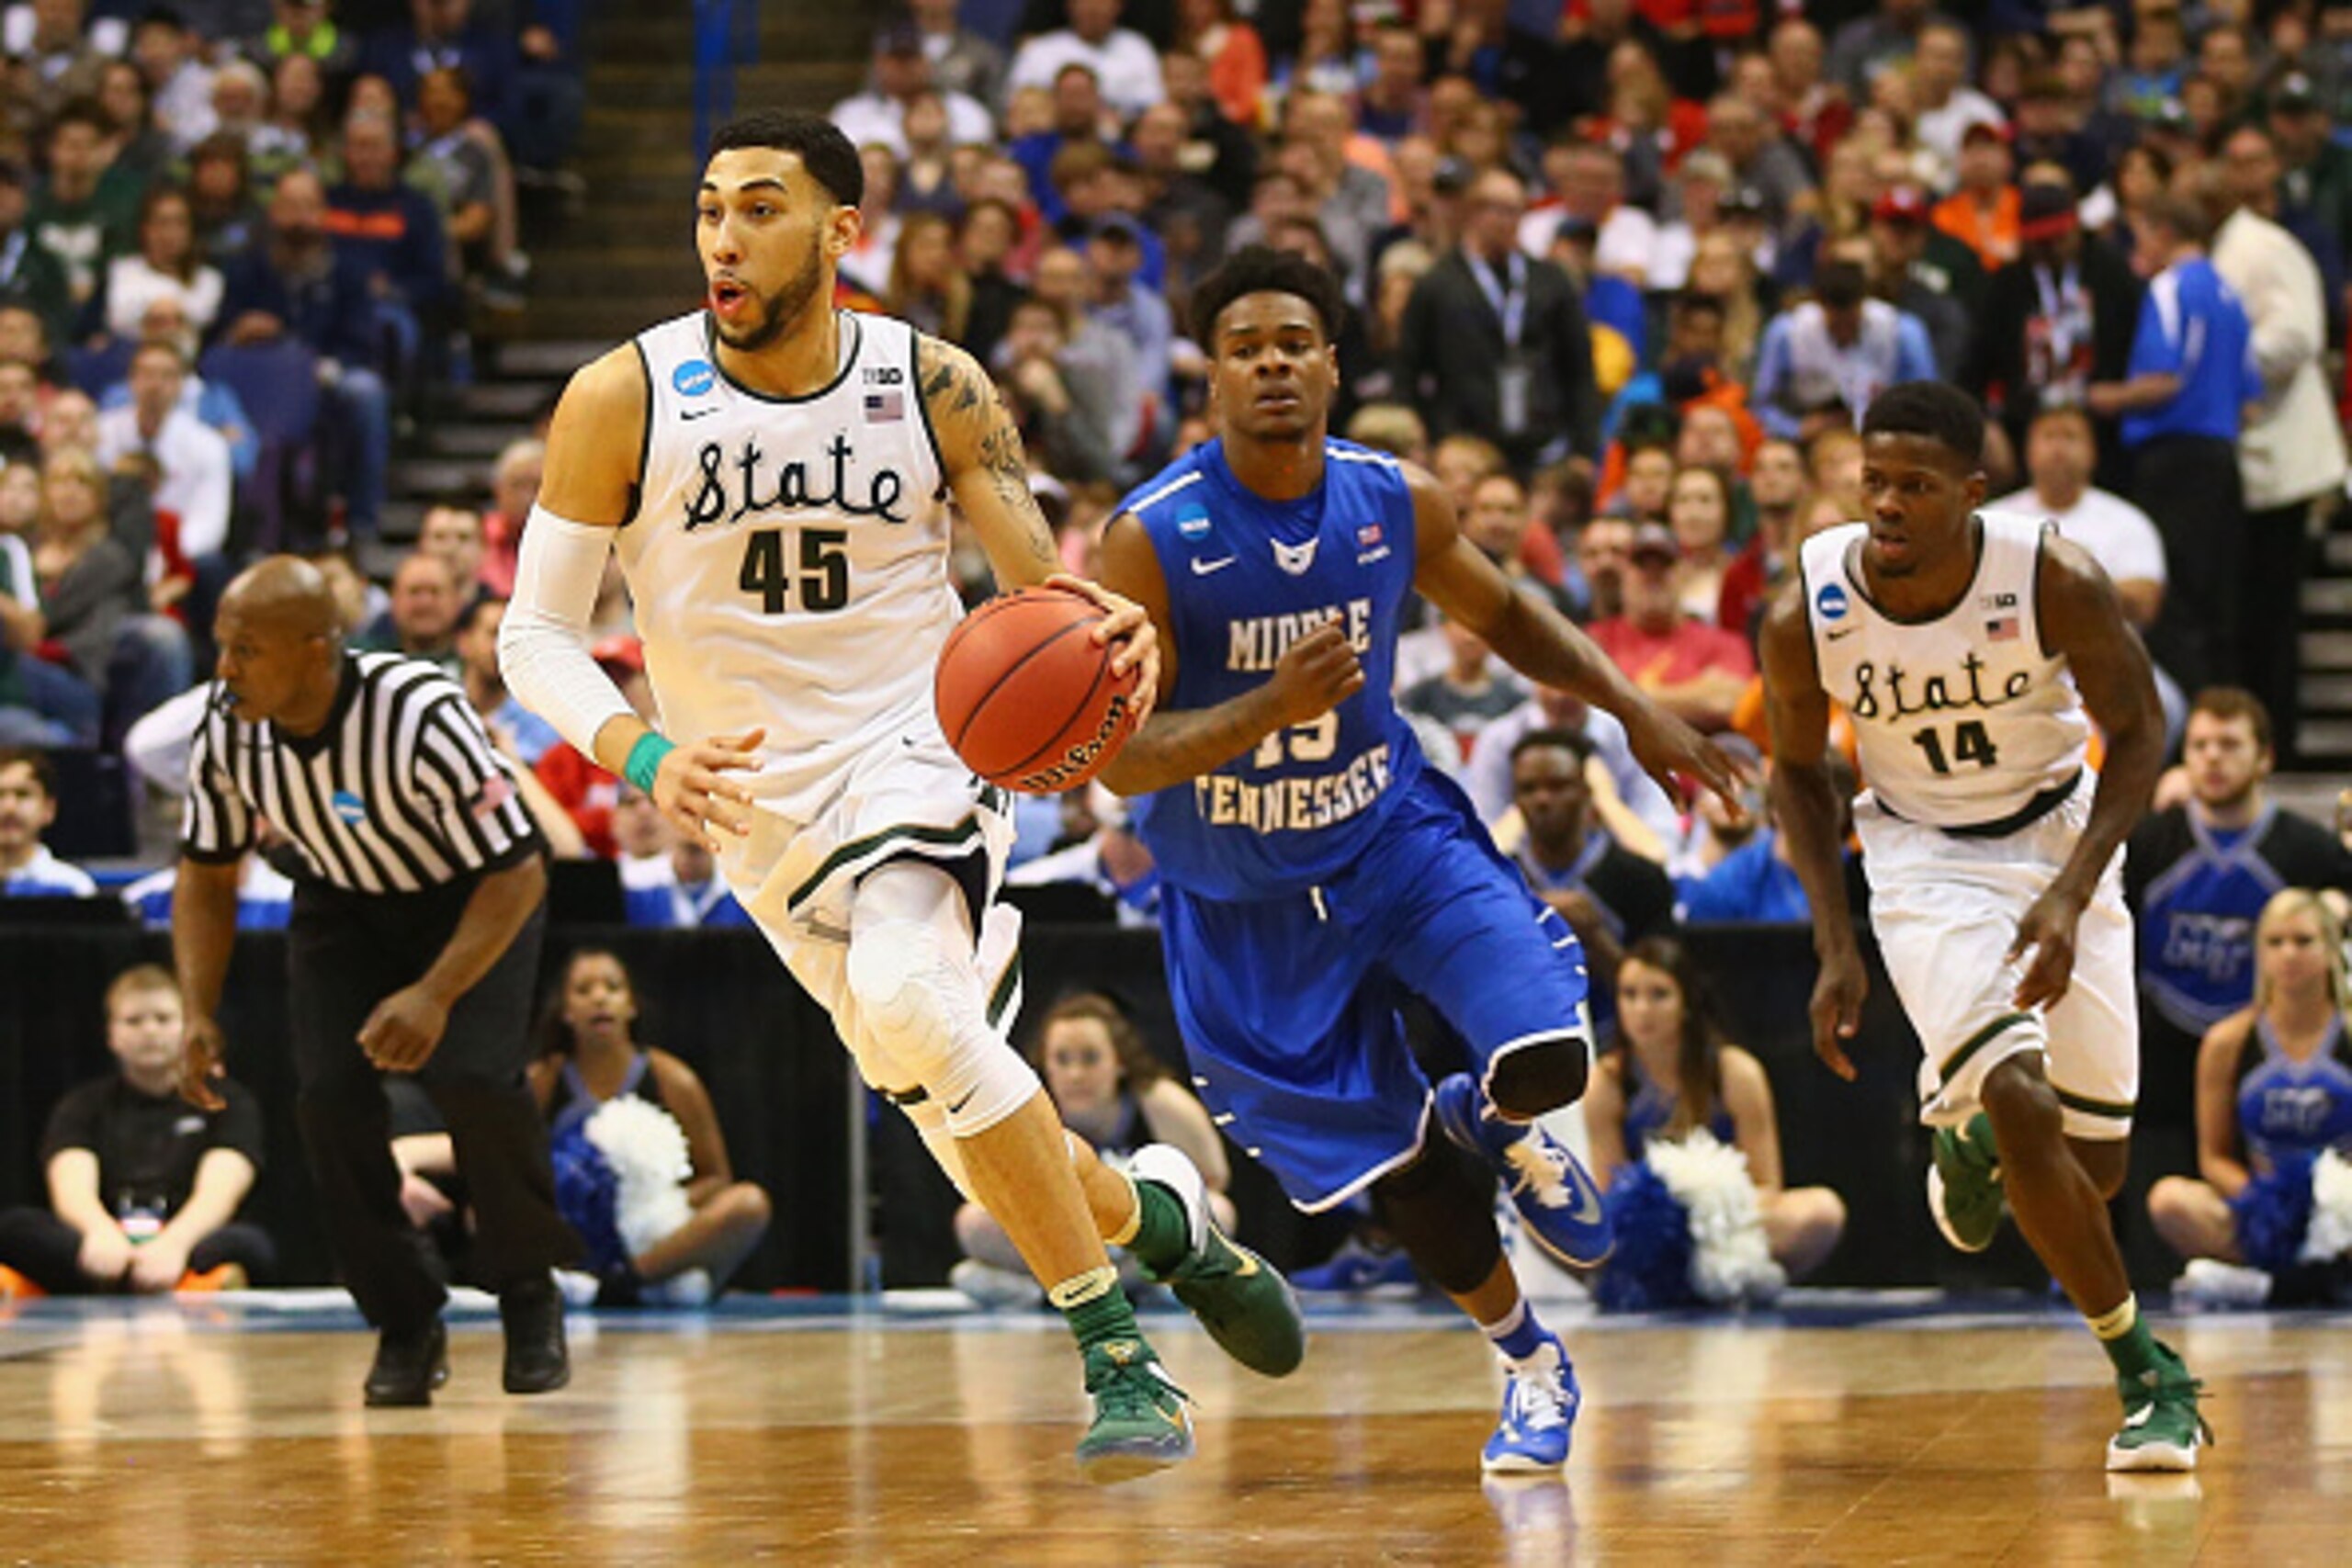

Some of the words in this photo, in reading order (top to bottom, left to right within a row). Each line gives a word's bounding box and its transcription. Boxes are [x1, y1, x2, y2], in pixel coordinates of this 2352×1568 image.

[684, 434, 906, 531] State
[739, 529, 849, 614] 45
[1227, 598, 1371, 671] MIDE
[1853, 651, 2031, 724] State
[1913, 720, 1997, 773] 14
